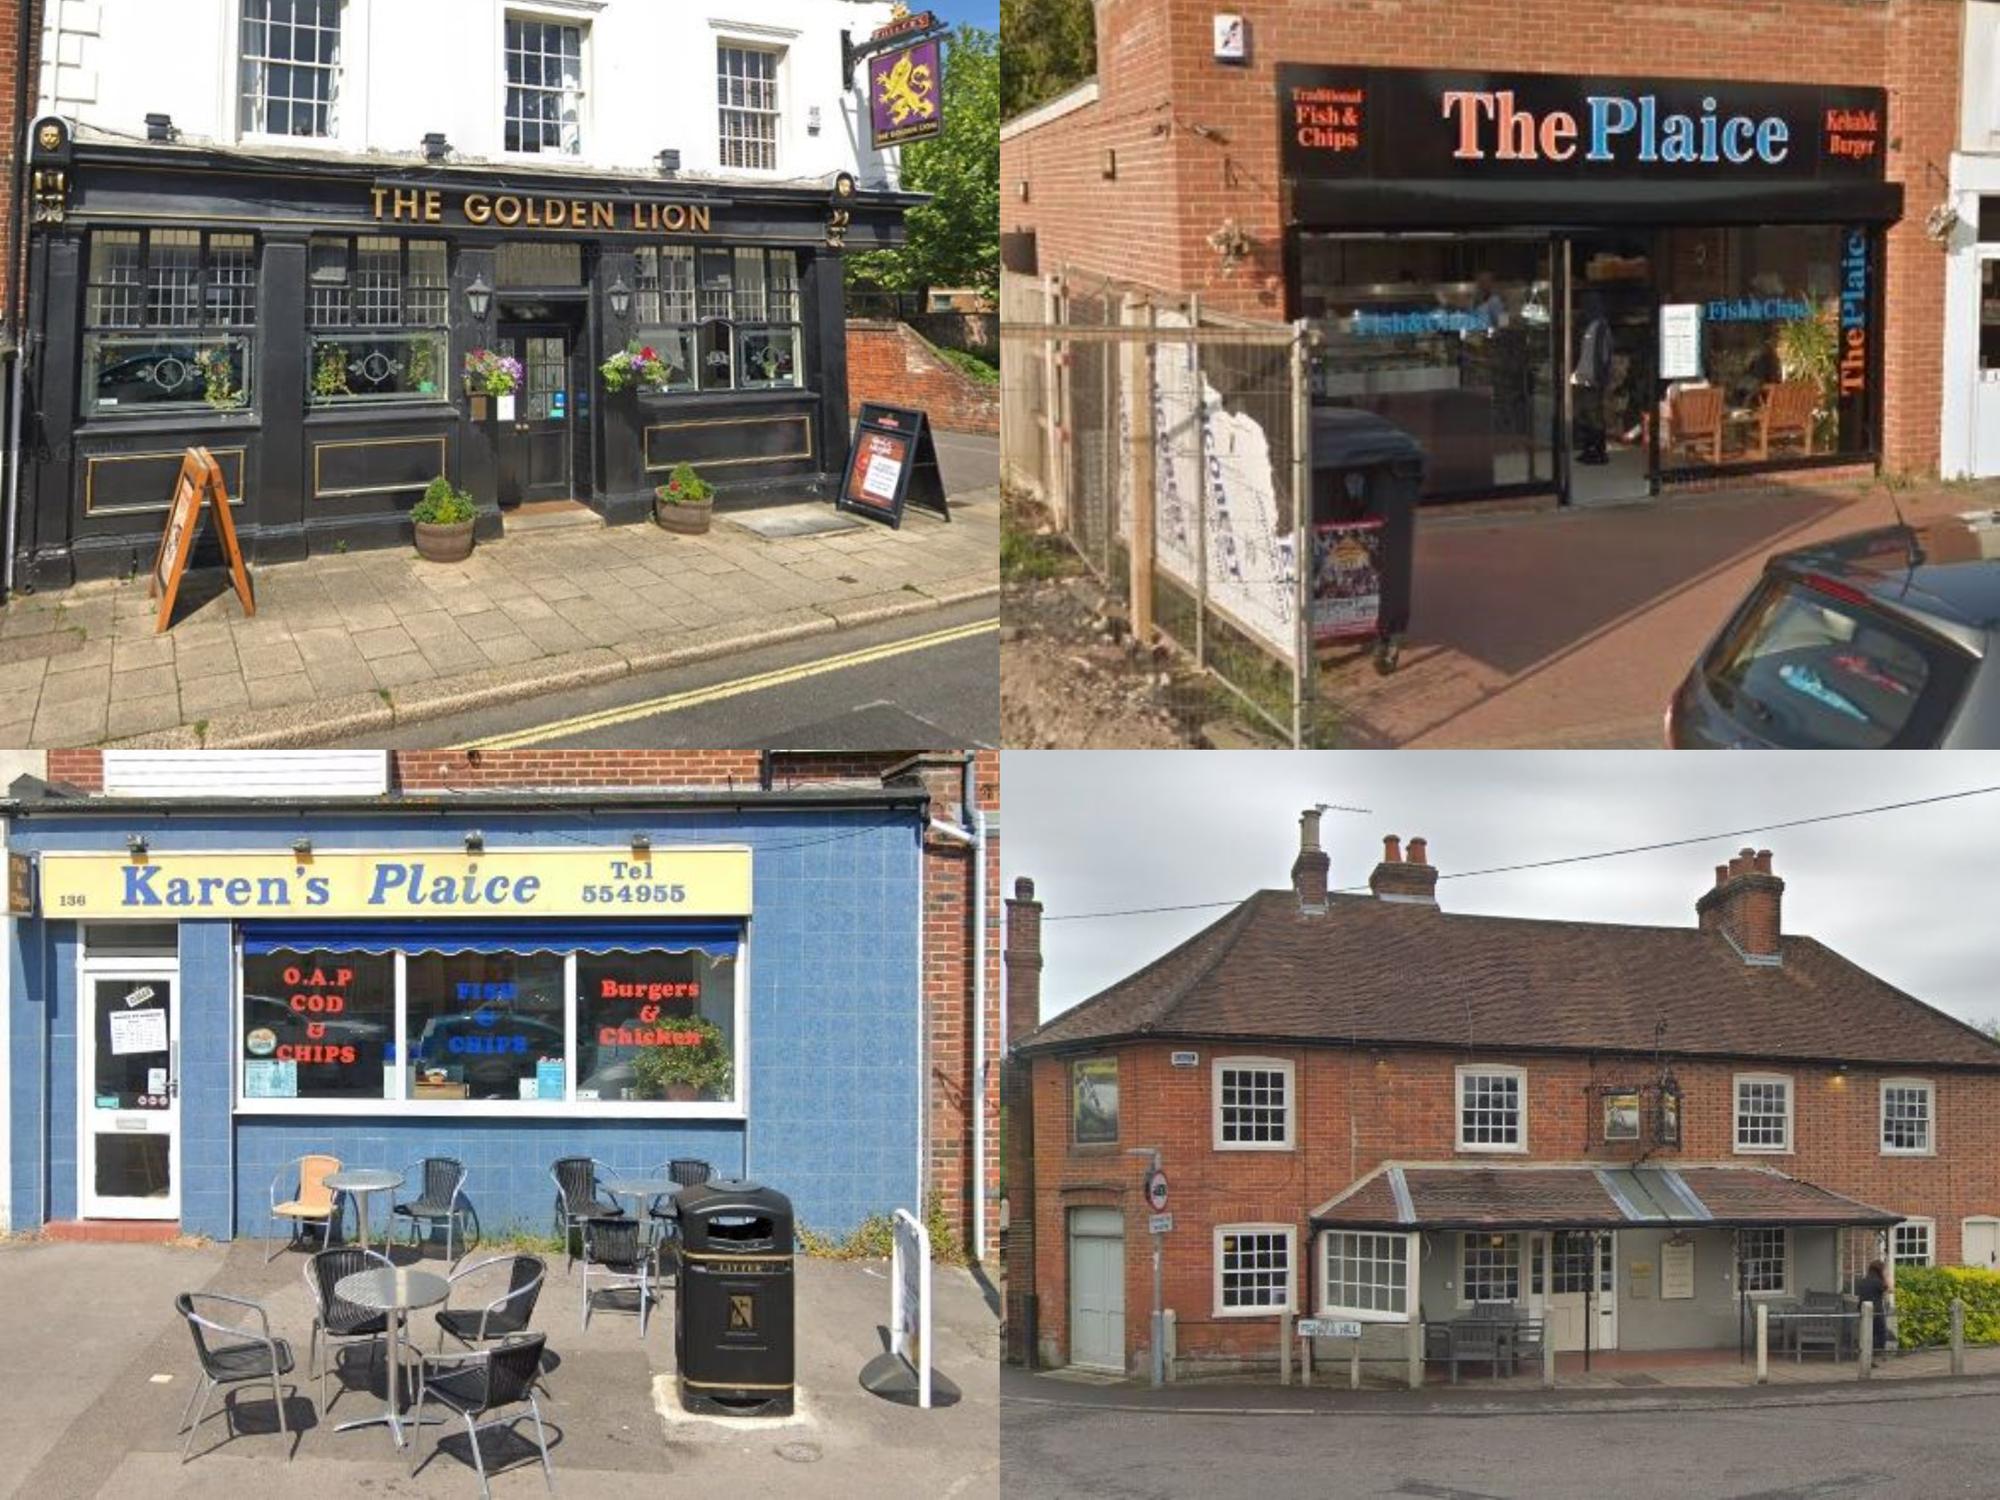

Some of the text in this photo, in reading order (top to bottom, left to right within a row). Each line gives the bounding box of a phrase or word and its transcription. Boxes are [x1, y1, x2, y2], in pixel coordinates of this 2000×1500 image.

[1290, 88, 1362, 103] Traditional
[1296, 105, 1359, 126] Fish &
[1443, 91, 1790, 164] The Plaice
[1298, 128, 1358, 151] Chips
[1830, 135, 1875, 159] Burger
[371, 188, 710, 231] THE GOLDEN LION
[1841, 327, 1865, 396] The
[611, 861, 653, 880] Tel
[120, 862, 542, 906] Karen's Plaice
[581, 884, 686, 903] 554955
[59, 895, 86, 906] 136
[283, 966, 352, 986] O.A.P
[601, 979, 700, 1002] Burgers
[290, 994, 344, 1013] COD
[639, 1005, 661, 1023] &
[448, 1034, 527, 1054] CHIPS
[599, 1026, 704, 1046] Chicken
[276, 1044, 356, 1064] CHIPS
